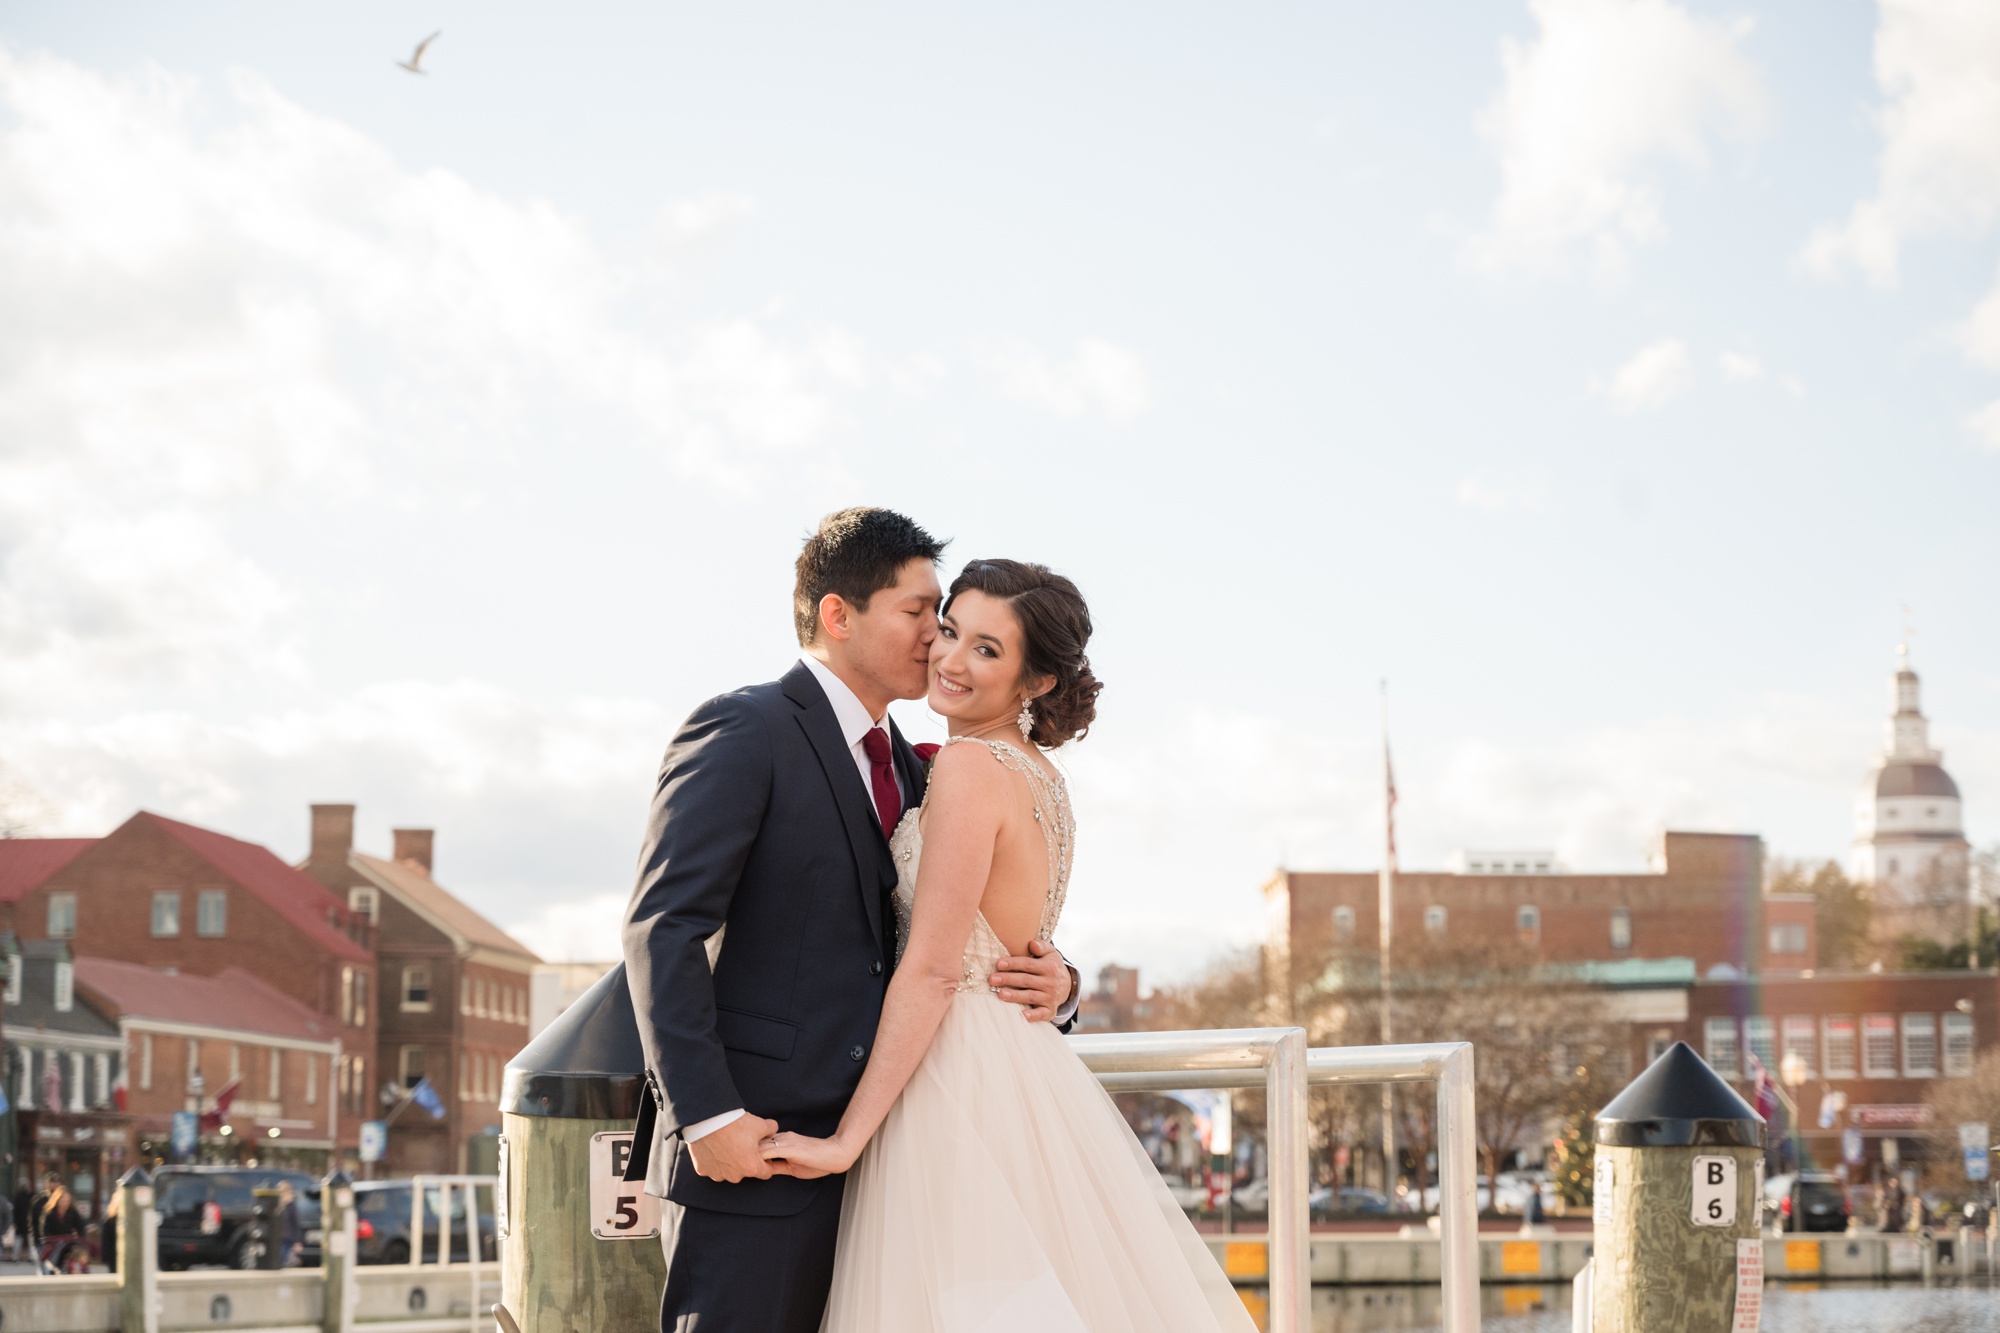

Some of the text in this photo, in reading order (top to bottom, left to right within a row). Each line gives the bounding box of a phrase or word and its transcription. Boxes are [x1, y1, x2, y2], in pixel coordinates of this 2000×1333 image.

[1708, 1162, 1724, 1185] B
[615, 1196, 638, 1230] 5
[1708, 1198, 1722, 1219] 6
